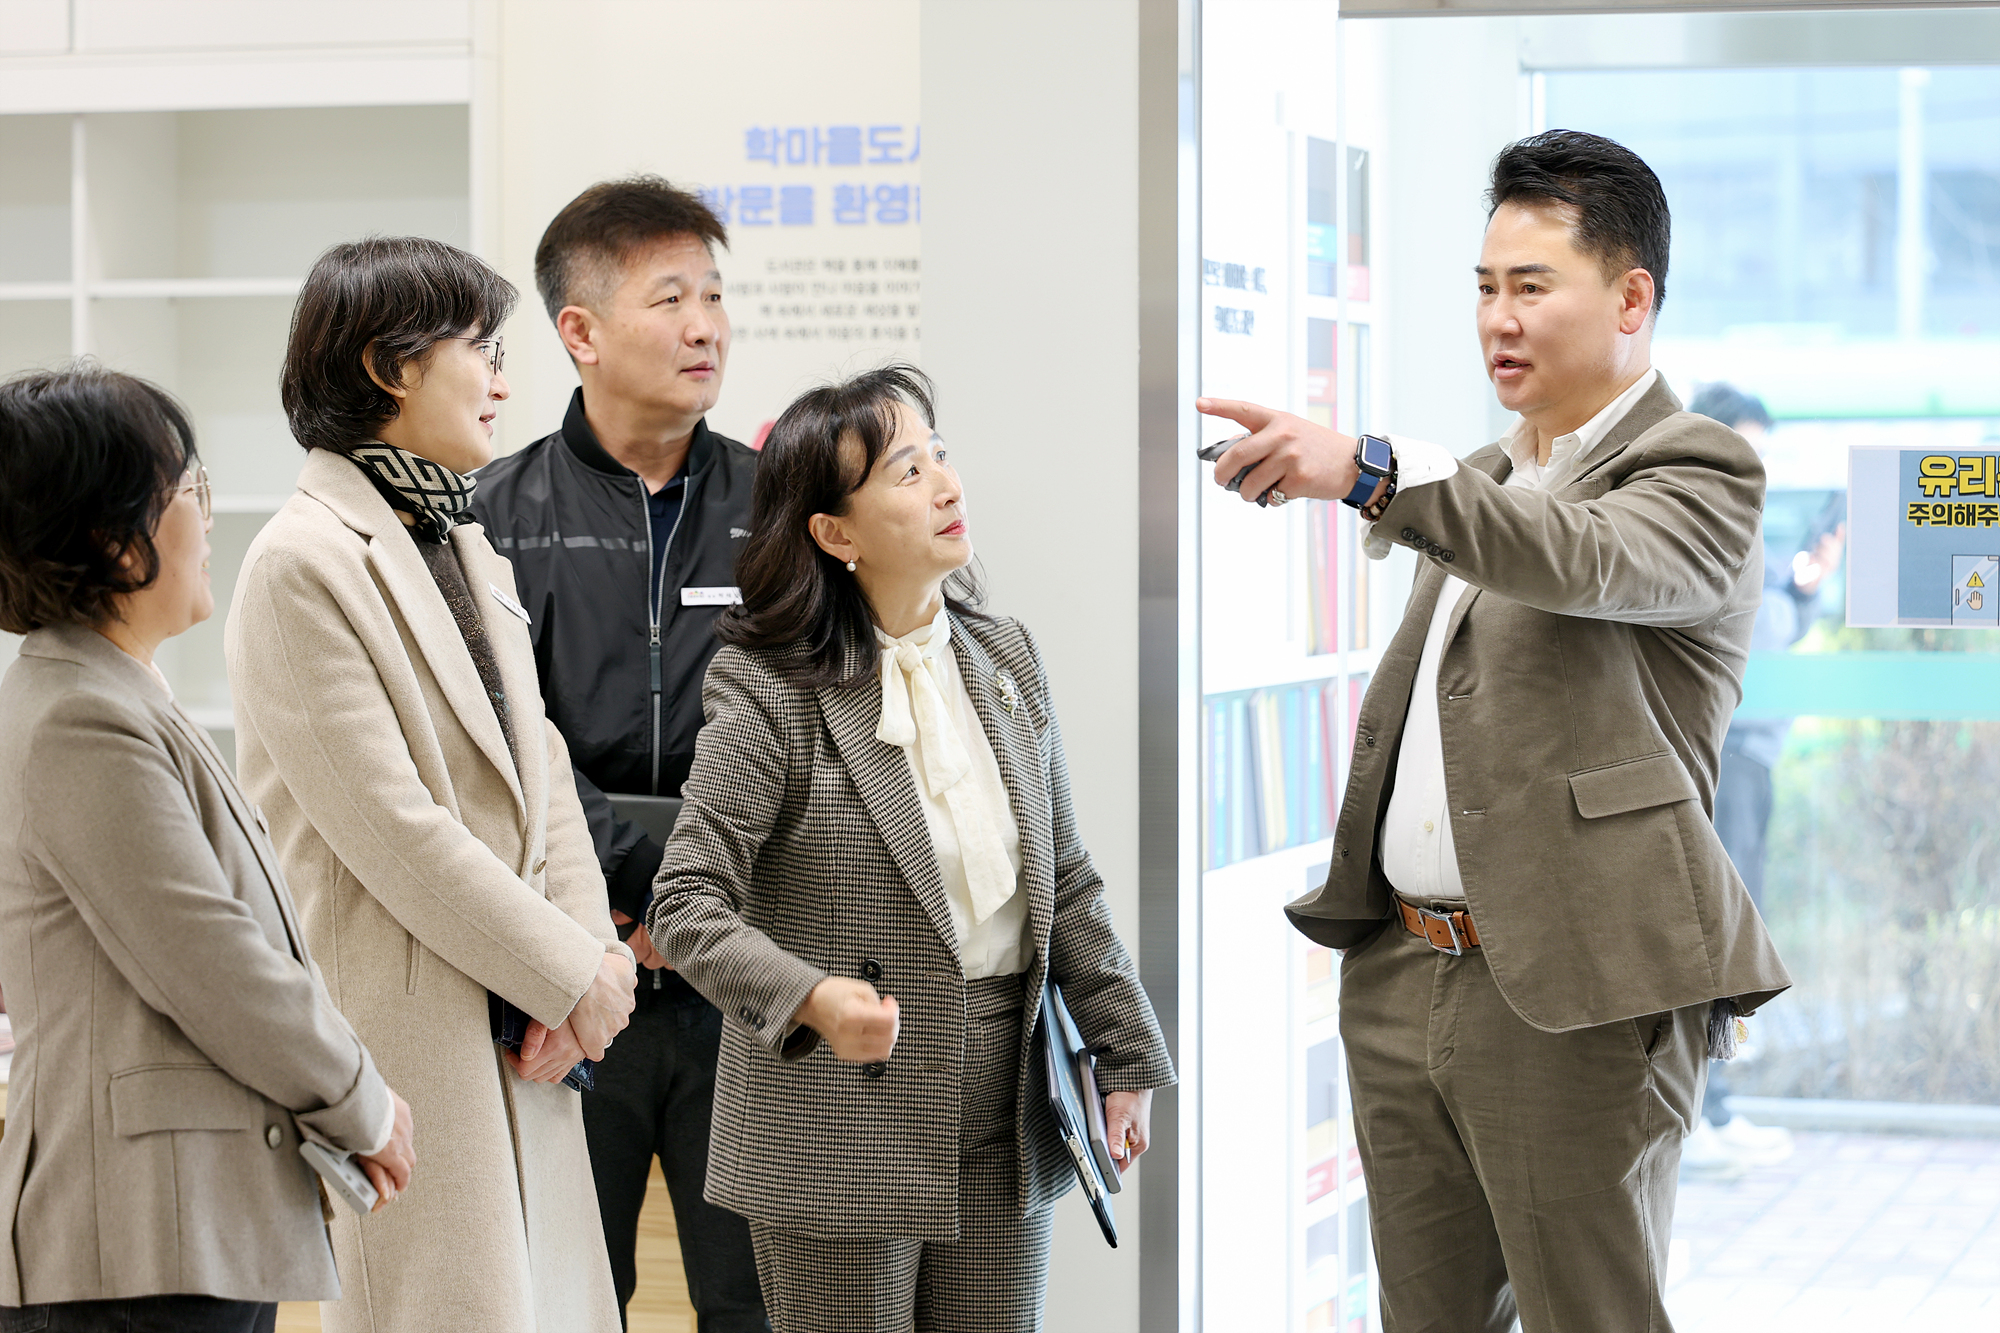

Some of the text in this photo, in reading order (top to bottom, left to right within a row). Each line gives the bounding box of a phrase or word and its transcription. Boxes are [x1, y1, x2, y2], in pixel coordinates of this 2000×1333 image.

[833, 184, 919, 225] 환영
[1918, 455, 2000, 498] 유리
[1907, 502, 2000, 528] 주의해주
